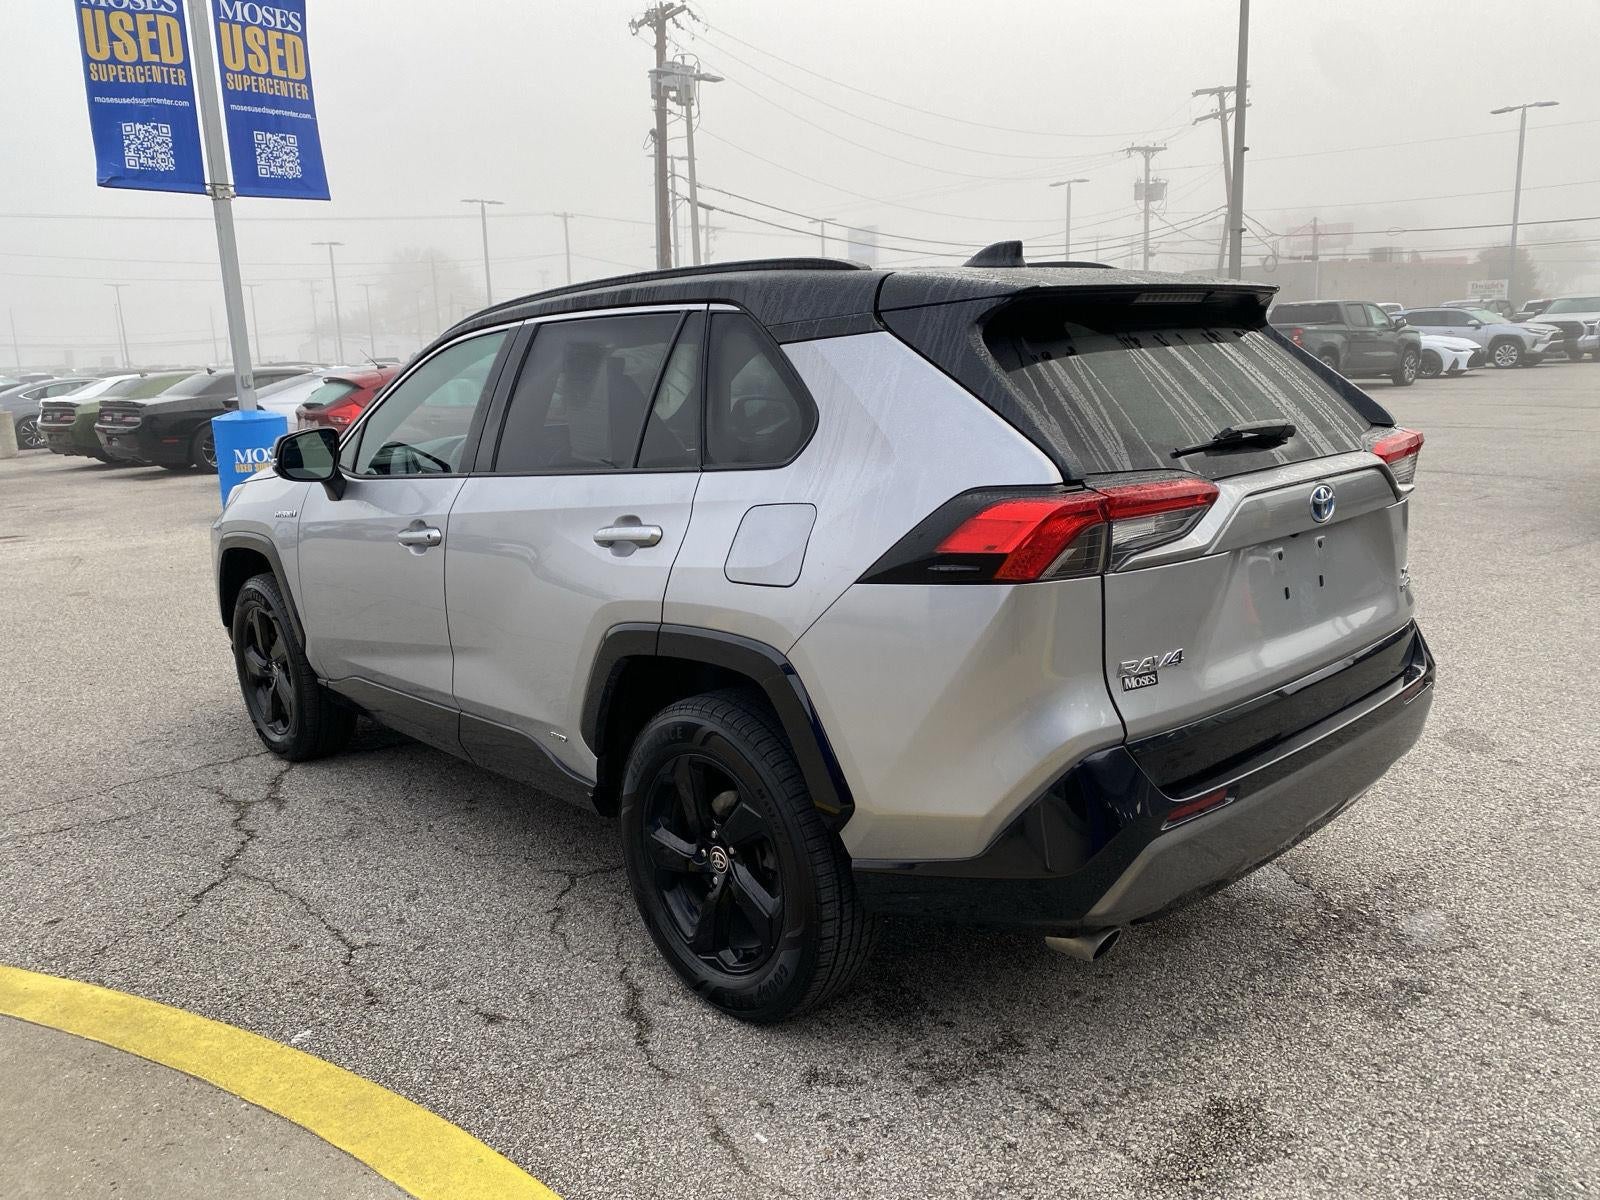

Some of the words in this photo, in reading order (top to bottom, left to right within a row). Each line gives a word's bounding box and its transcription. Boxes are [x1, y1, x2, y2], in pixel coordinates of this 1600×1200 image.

[219, 0, 302, 33] MOSES
[81, 8, 184, 64] USED
[219, 22, 306, 80] USED
[89, 63, 187, 86] SUPERCENTER
[226, 72, 309, 100] SUPERCENTER
[94, 96, 190, 107] mosesusedsupercenter.com
[230, 104, 312, 120] mosesusedsupercenter.com
[1116, 648, 1184, 678] RAV4
[1124, 674, 1156, 690] MOSES
